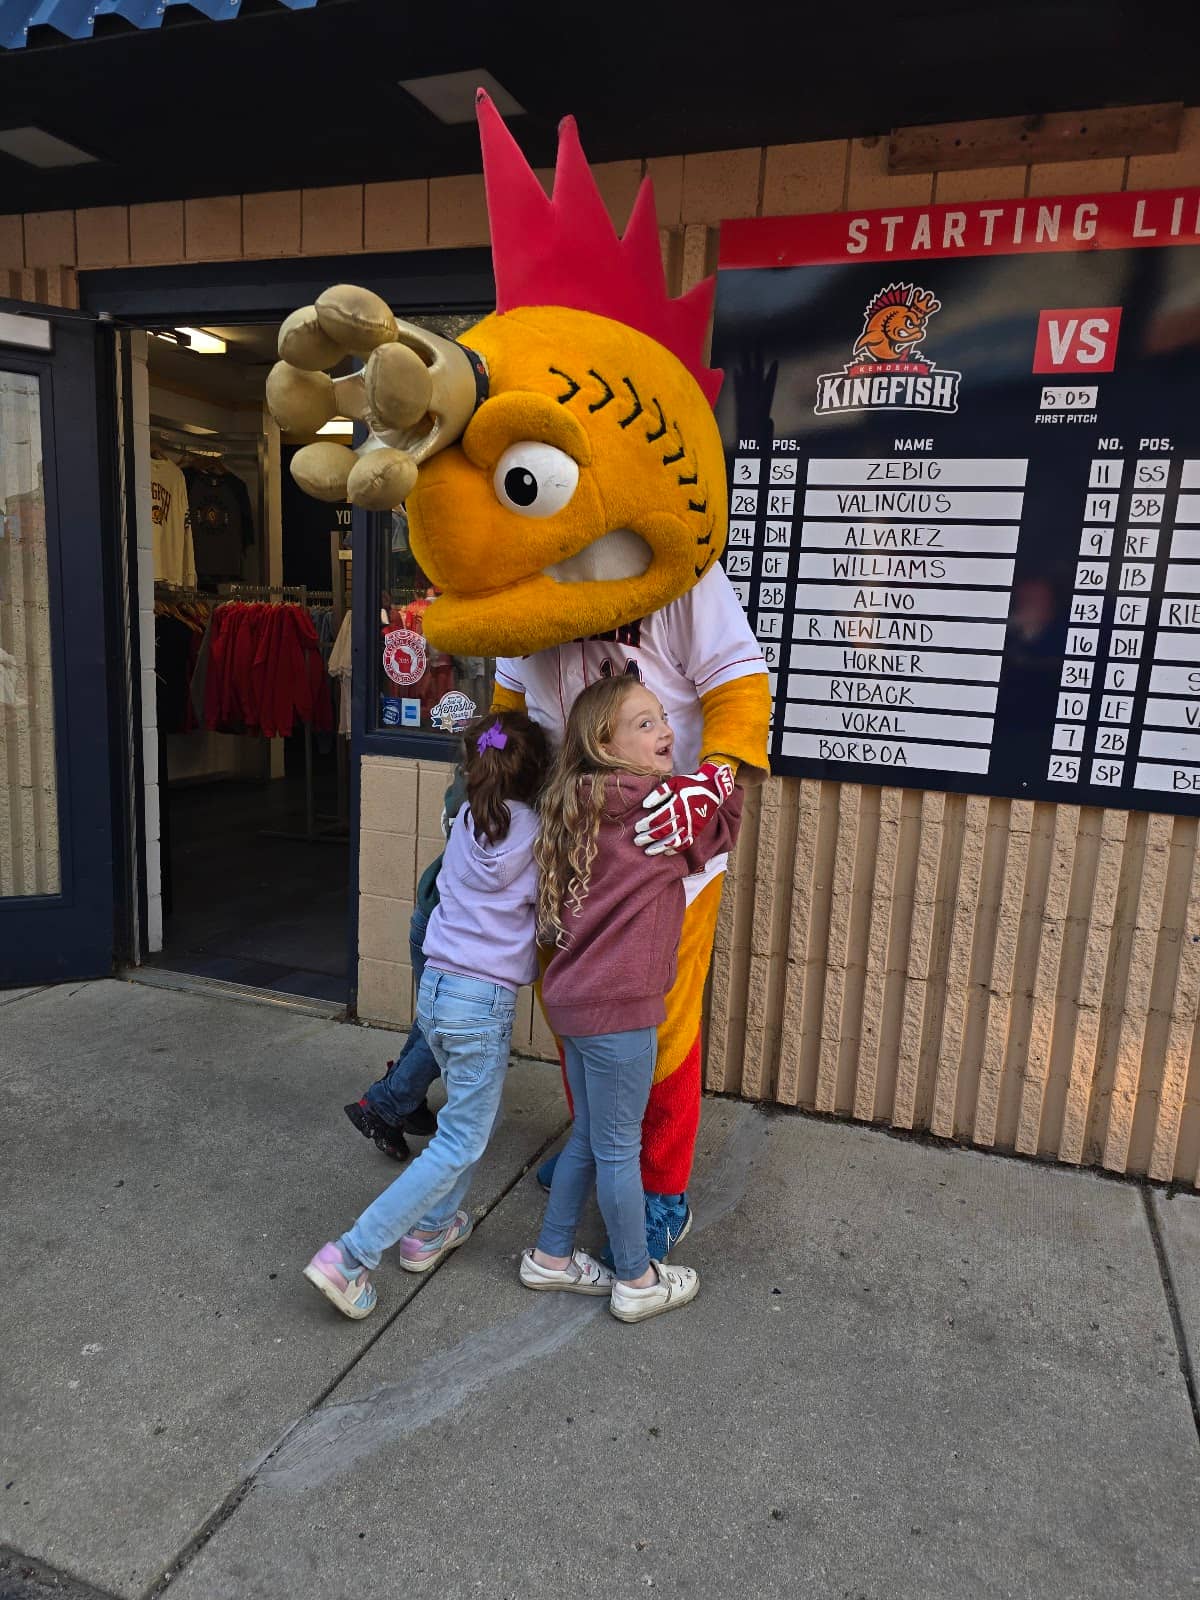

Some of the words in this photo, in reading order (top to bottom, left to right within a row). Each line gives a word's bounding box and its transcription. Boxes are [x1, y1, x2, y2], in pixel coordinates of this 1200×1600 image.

[846, 203, 1099, 254] STARTING
[1048, 318, 1109, 365] VS
[859, 364, 918, 373] KENOSHA
[821, 376, 954, 409] KINGFISH
[1035, 414, 1065, 424] FIRST
[1066, 414, 1097, 424] PITCH
[739, 439, 760, 450] NO.
[772, 439, 800, 451] POS.
[894, 439, 934, 451] NAME
[1098, 438, 1124, 450] NO.
[1139, 438, 1175, 450] POS.
[740, 464, 752, 480] 3
[771, 465, 794, 480] SS
[867, 461, 942, 480] ZEBIG
[1138, 465, 1165, 483] SS
[734, 495, 756, 513] 28
[770, 496, 792, 515] RF
[837, 493, 952, 514] VALINCIUS
[1092, 500, 1111, 519] 19
[1130, 499, 1161, 518] 3B
[335, 510, 352, 525] YO
[731, 527, 752, 543] 24
[766, 526, 788, 544] DH
[844, 527, 944, 548] ALVAREZ
[1090, 534, 1103, 555] 9
[1125, 536, 1151, 555] RF
[728, 556, 752, 574] 25
[764, 557, 783, 574] CF
[832, 556, 947, 579] WILLIAMS
[1079, 569, 1104, 586] 26
[762, 587, 784, 606] 3B
[853, 589, 915, 610] ALIVO
[1074, 603, 1099, 621] 43
[1119, 603, 1142, 623] CF
[760, 618, 777, 634] LF
[833, 617, 934, 643] NEWLAND
[1072, 635, 1093, 653] 16
[1114, 638, 1138, 657] DH
[843, 651, 924, 673] HORNER
[1065, 666, 1090, 687] 34
[1113, 669, 1125, 688] C
[830, 679, 914, 705] RYBACK
[841, 712, 906, 734] VOKAL
[1064, 698, 1084, 716] 10
[1104, 701, 1129, 720] LF
[1185, 706, 1200, 728] V
[1062, 729, 1076, 747] 7
[1101, 734, 1125, 751] 2B
[819, 739, 907, 765] BORBOA
[1051, 761, 1077, 779] 25
[1096, 765, 1121, 783] SP
